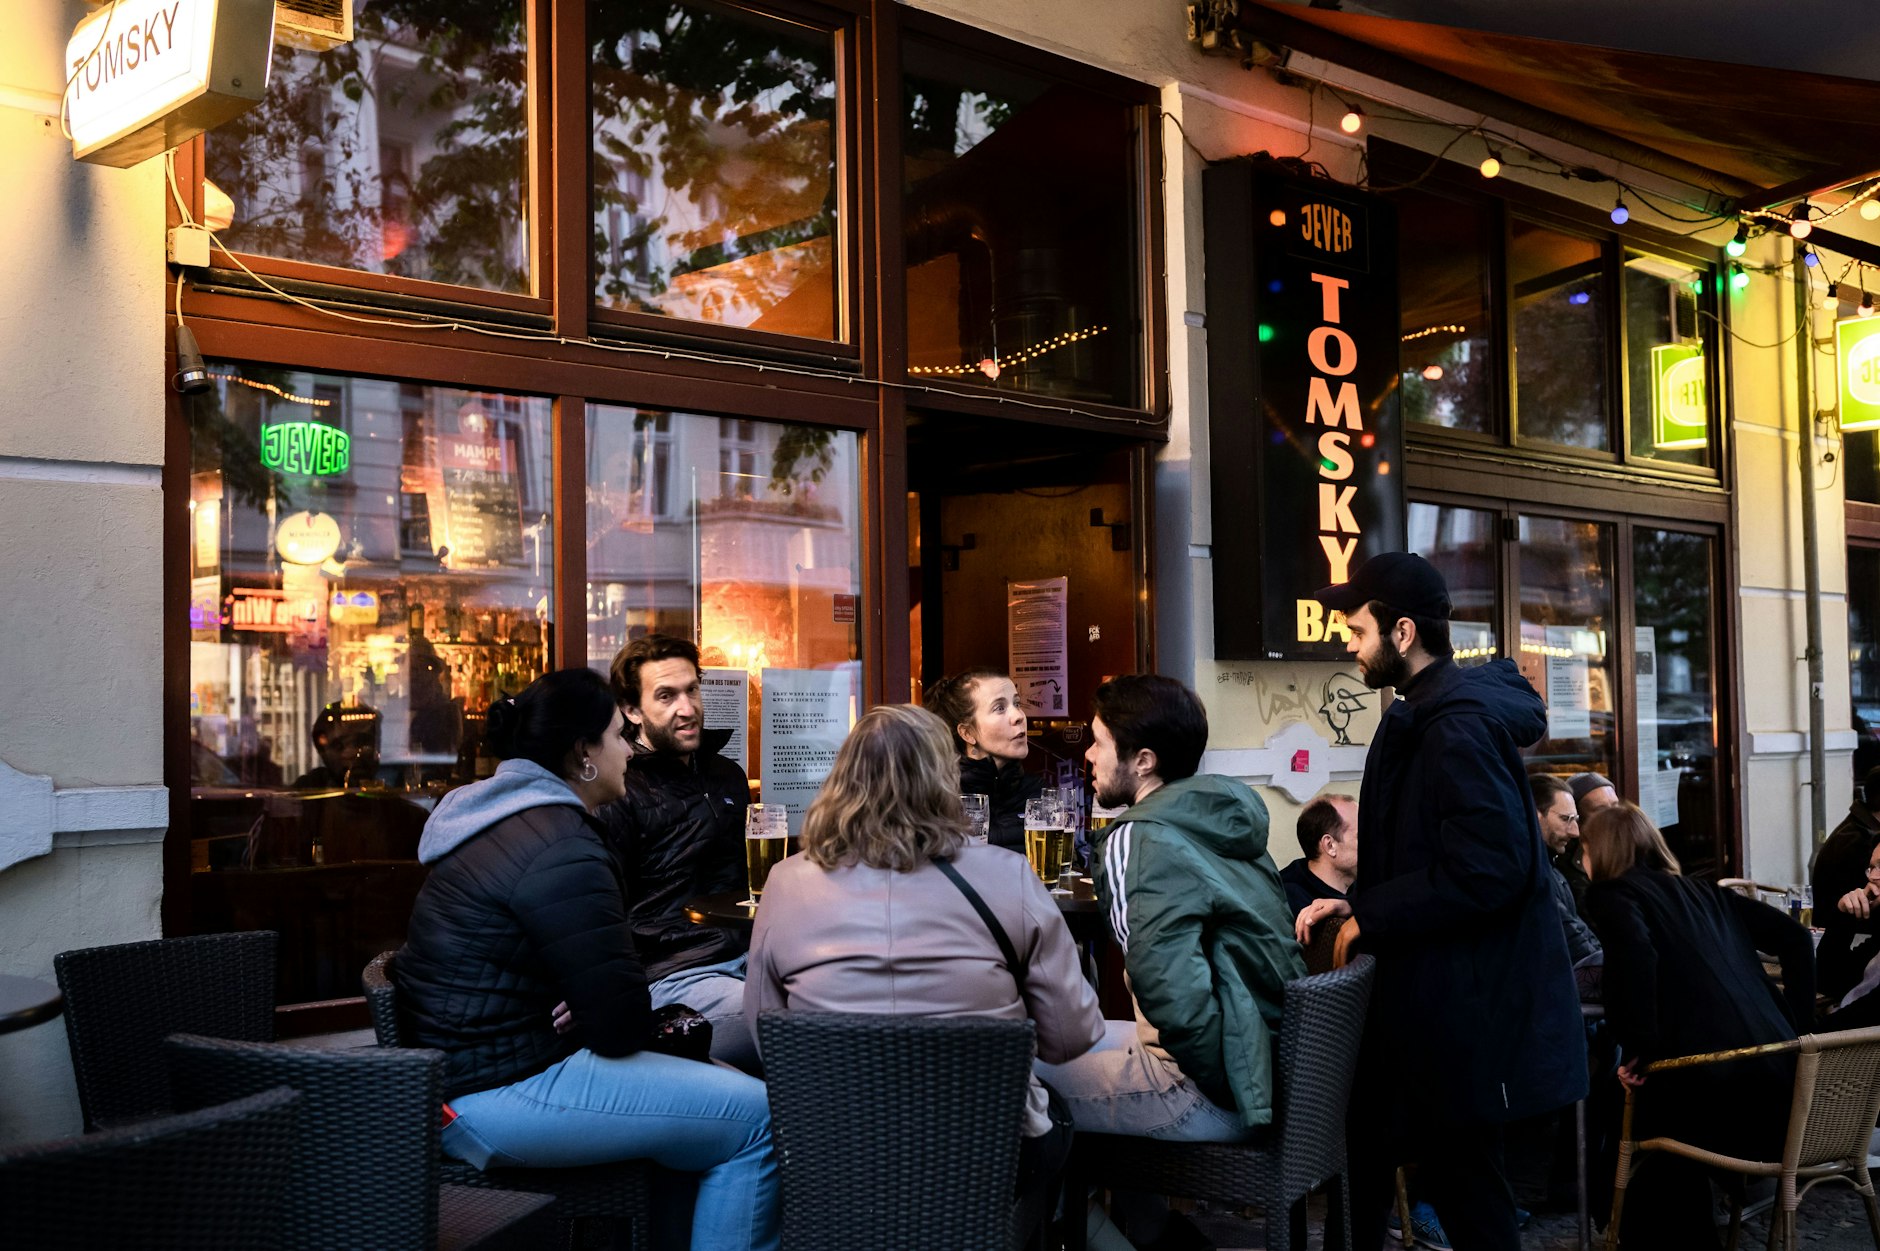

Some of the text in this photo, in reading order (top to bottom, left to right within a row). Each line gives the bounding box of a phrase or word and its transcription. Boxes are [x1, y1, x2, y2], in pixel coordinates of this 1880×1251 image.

[72, 1, 181, 100] TOMSKY
[1301, 202, 1353, 254] JEVER
[261, 421, 351, 476] JEVER
[454, 443, 502, 462] MAMPE
[1305, 272, 1364, 586] TOMSKY
[1297, 599, 1352, 643] BA
